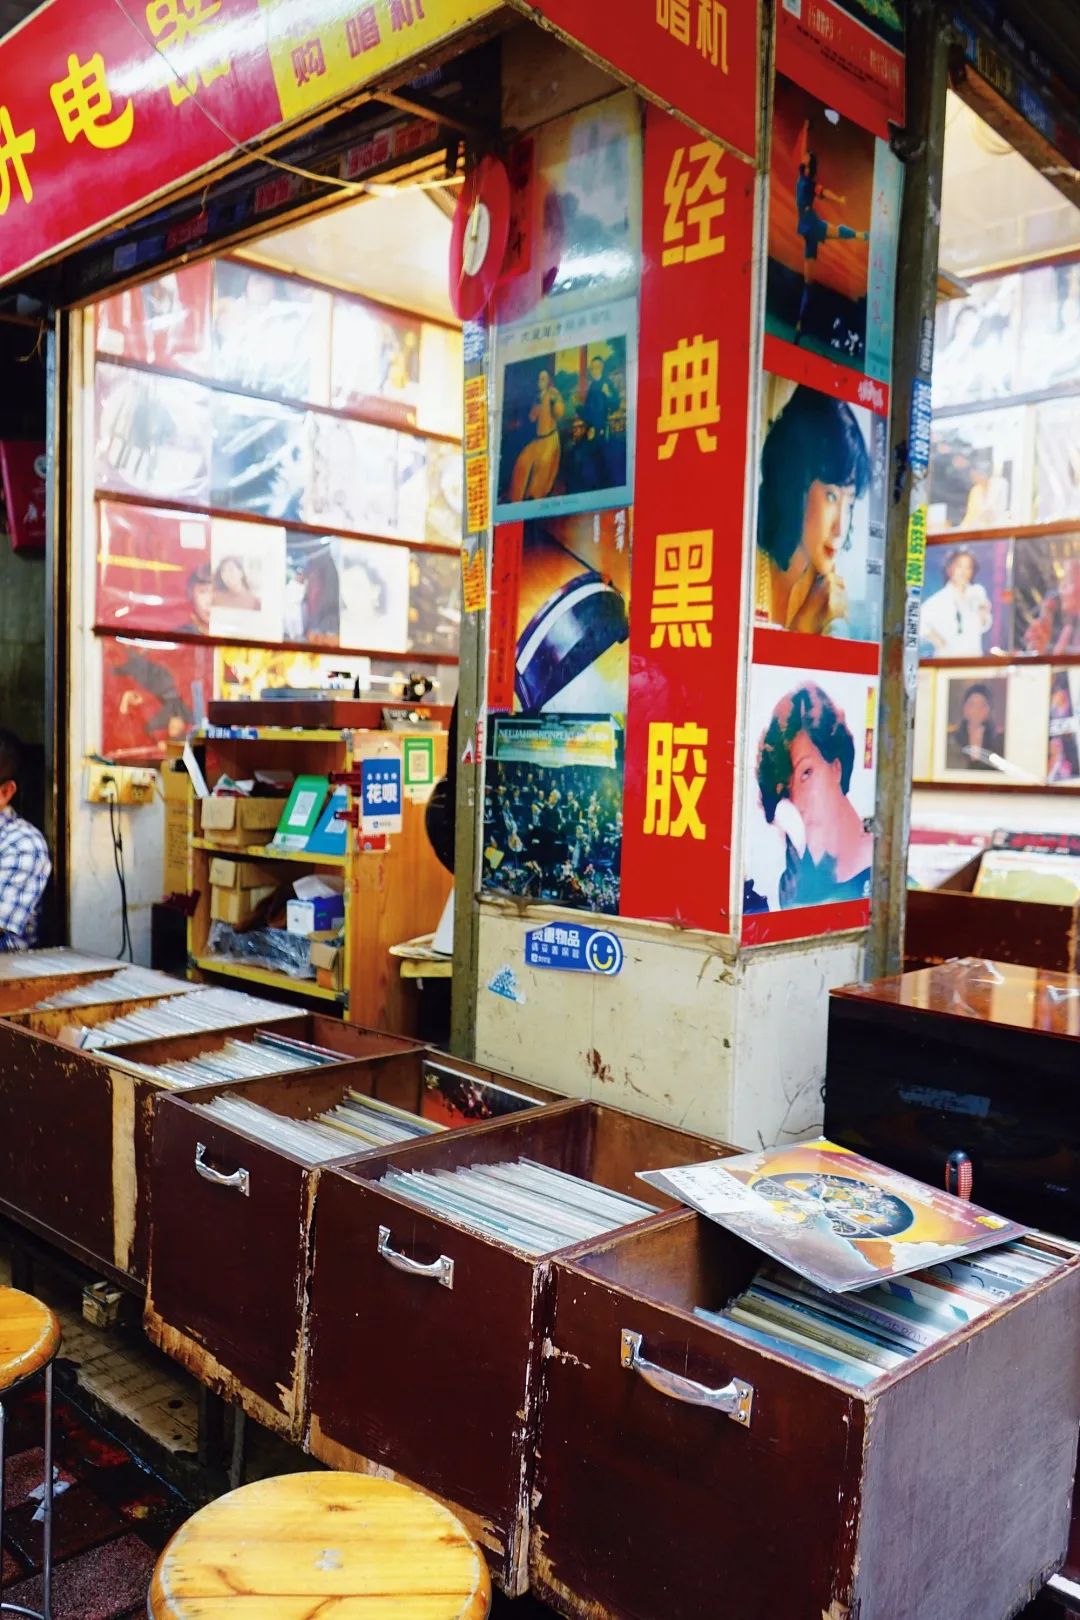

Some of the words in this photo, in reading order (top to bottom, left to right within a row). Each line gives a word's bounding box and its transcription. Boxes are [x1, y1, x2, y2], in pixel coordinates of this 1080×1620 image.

[642, 139, 728, 840] 经典黑胶
[366, 782, 398, 804] 花呗
